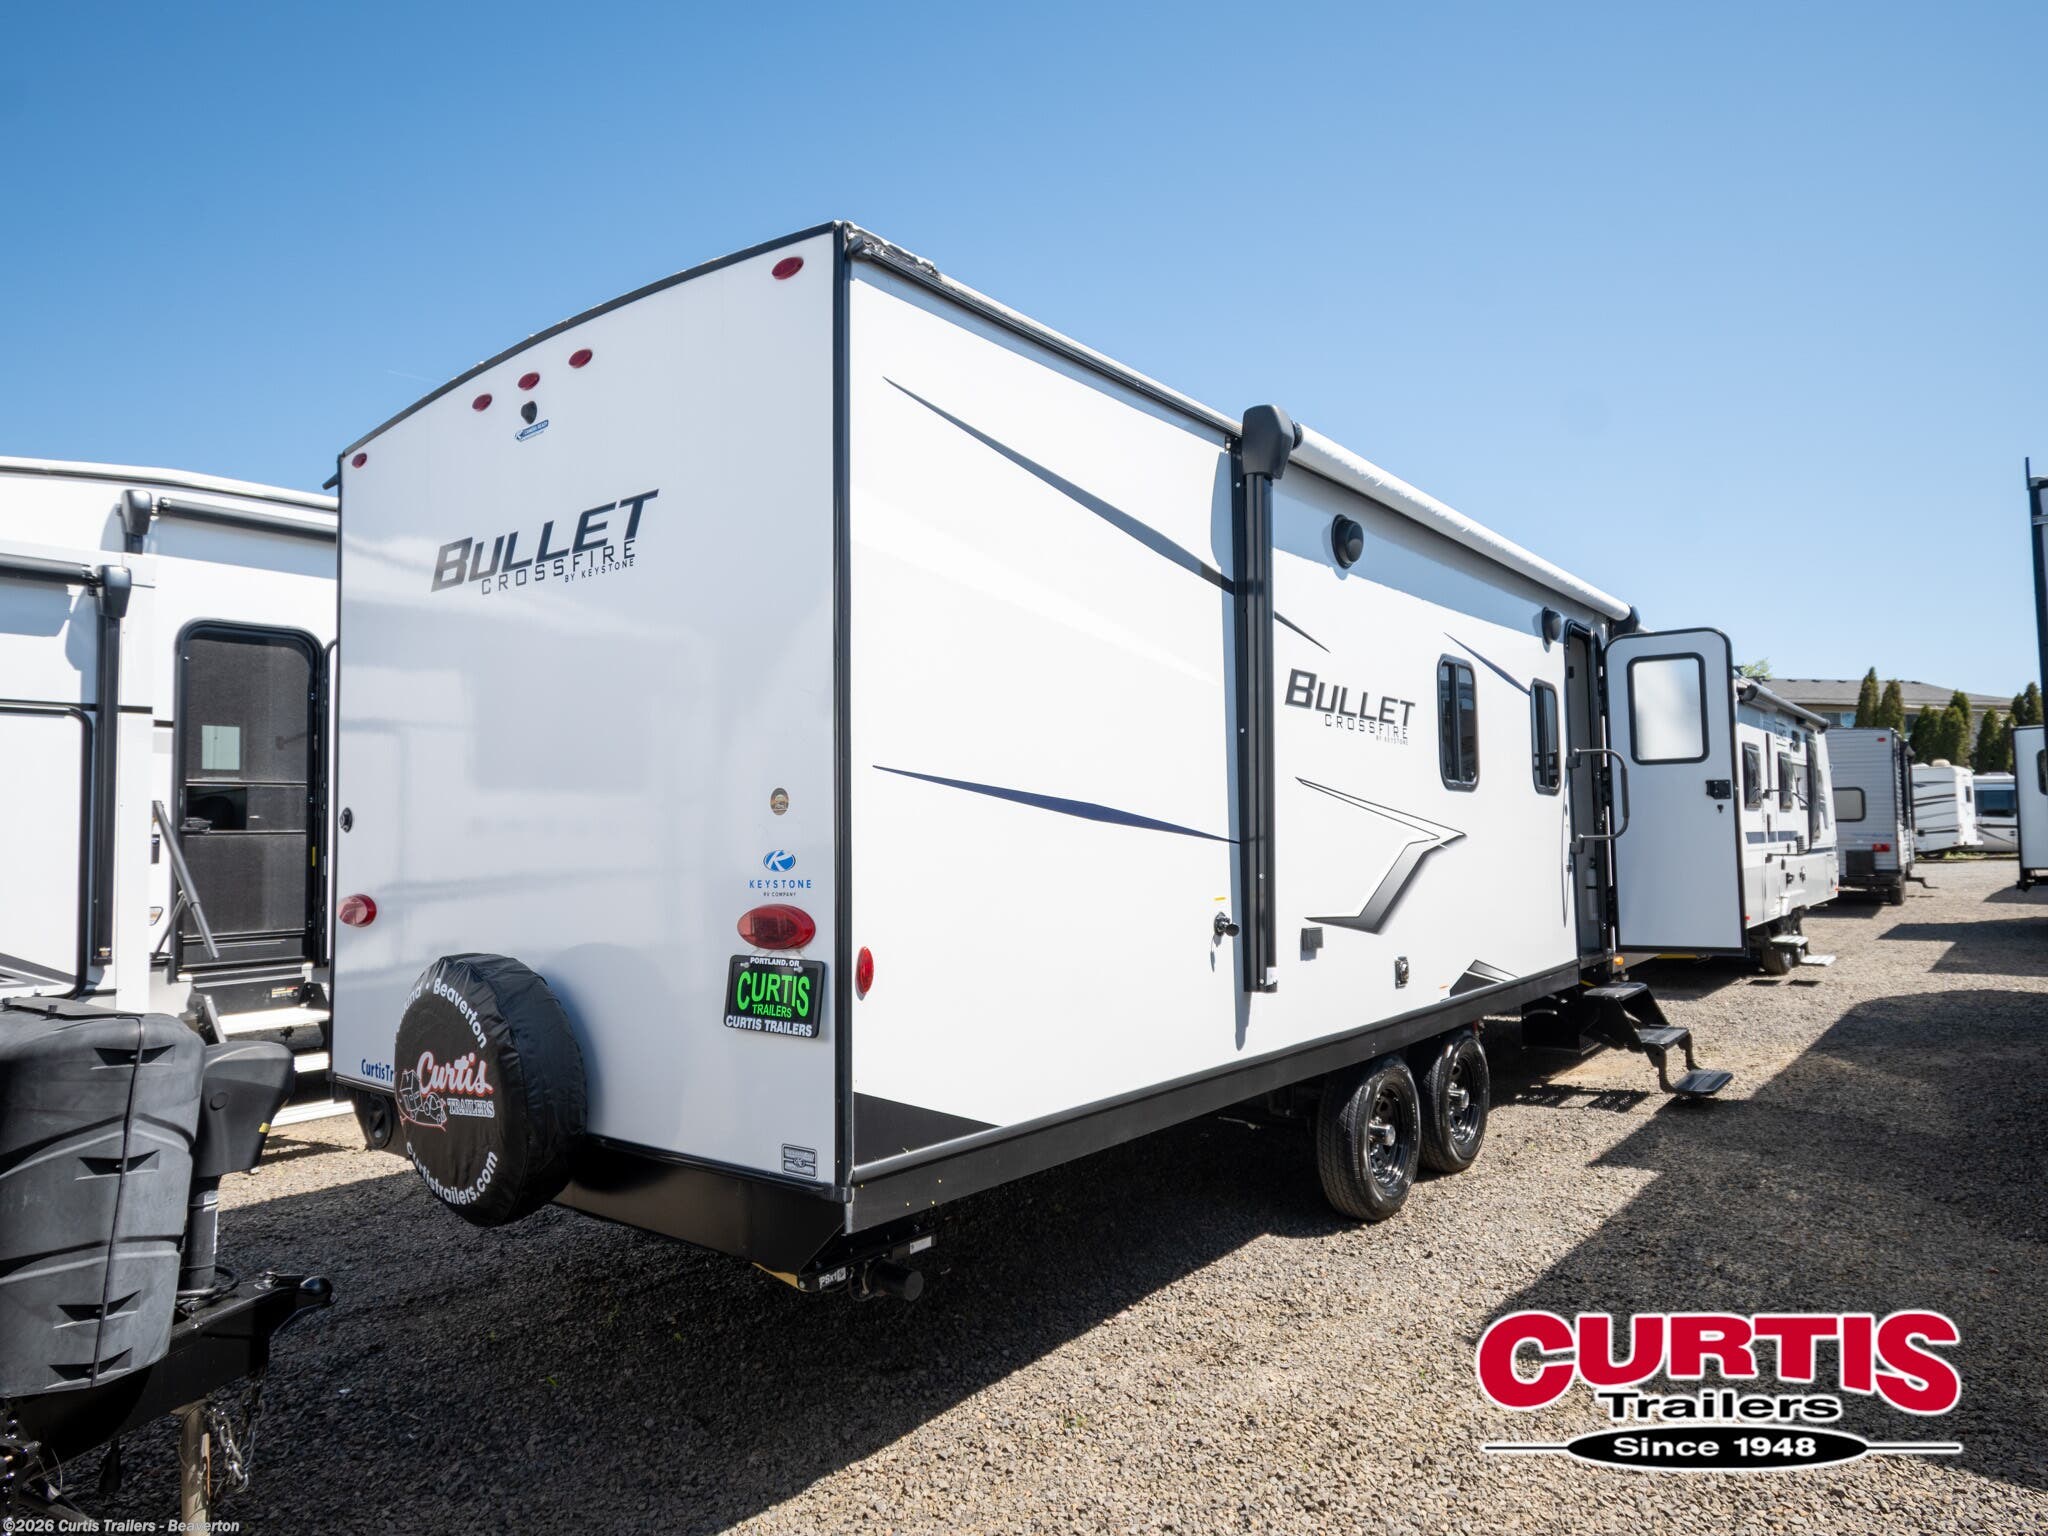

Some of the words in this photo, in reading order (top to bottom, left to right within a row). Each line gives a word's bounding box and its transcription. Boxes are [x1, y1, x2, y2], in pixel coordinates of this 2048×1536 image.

[431, 488, 659, 592] BULLET
[481, 540, 635, 595] CROSSFIRE
[564, 573, 575, 583] BY
[582, 557, 634, 579] KEYSTONE
[1285, 668, 1416, 727] BULLET
[1325, 713, 1408, 740] CROSSFIRE
[749, 879, 812, 889] KEYSTONE
[737, 971, 810, 1017] CURTIS
[433, 977, 487, 1048] Beaverton
[752, 1004, 792, 1018] TRAILERS
[725, 1015, 762, 1031] CURTIS
[764, 1019, 812, 1037] TRAILERS
[361, 1058, 394, 1081] CurtisTr
[417, 1051, 494, 1097] Curtis
[447, 1098, 495, 1118] TRAILERS
